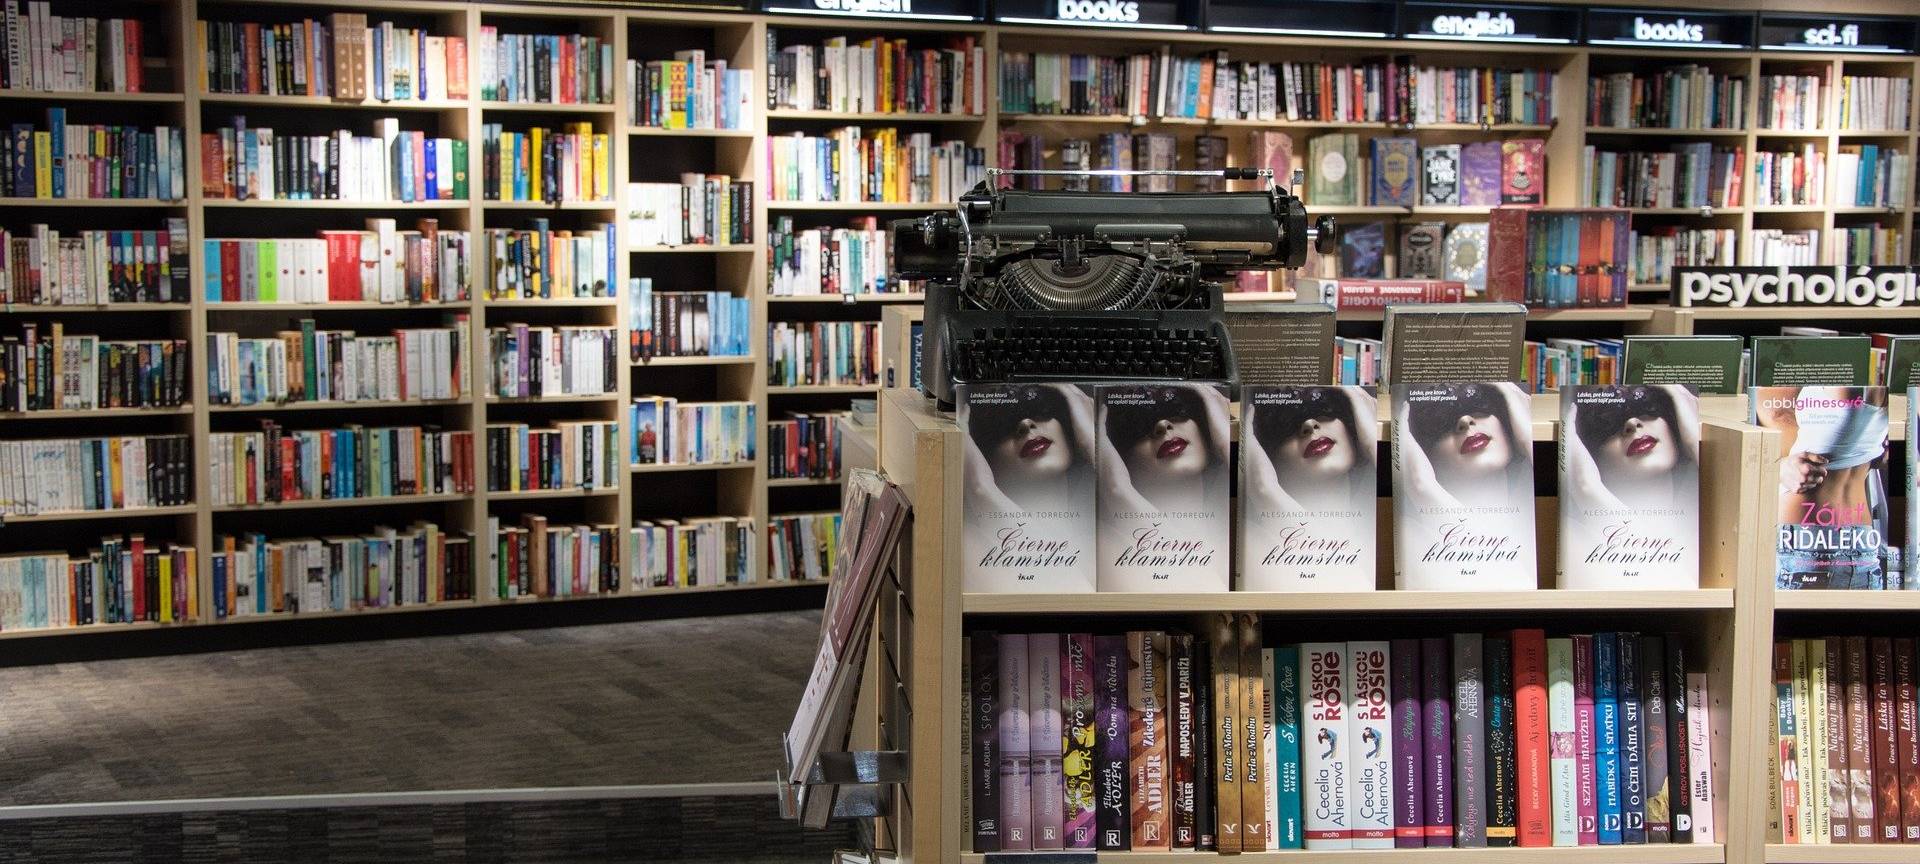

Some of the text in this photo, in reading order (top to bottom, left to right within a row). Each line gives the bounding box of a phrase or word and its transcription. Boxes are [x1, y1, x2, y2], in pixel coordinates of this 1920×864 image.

[1058, 0, 1139, 22] books
[1432, 11, 1515, 37] english
[1634, 17, 1703, 41] books
[1804, 24, 1858, 45] sci-fi
[1680, 265, 1920, 308] psychológi
[1037, 510, 1081, 519] TORREOVÁ
[1113, 510, 1216, 519] ALESSANDRA TORREOVÁ
[1260, 510, 1362, 518] ALESSANDRA TORREOVÁ
[1419, 506, 1521, 514] ALESSANDRA TORREOVÁ
[1583, 508, 1685, 516] ALESSANDRA TORREOVÁ
[1801, 501, 1865, 531] Zájsť
[997, 522, 1068, 551] Čierne
[1132, 522, 1203, 551] Čierne
[1280, 522, 1350, 550] Čierne
[1439, 518, 1509, 546] Čierne
[1603, 520, 1672, 548] Čierne
[1779, 527, 1881, 550] RIĎALEKO
[979, 546, 1080, 567] klamstvá
[1115, 546, 1215, 567] klamstvá
[1261, 545, 1361, 566] klamstvá
[1422, 542, 1521, 562] klamstvá
[1584, 544, 1684, 564] klamstvá
[1178, 657, 1190, 689] PARÍŽI
[1310, 652, 1323, 707] LÁSKOU
[1355, 651, 1369, 720] S LÁSKOU
[982, 672, 993, 729] SPOLOK
[1072, 643, 1085, 736] Prosím, mlč
[1110, 697, 1118, 709] na
[1143, 636, 1156, 747] Zdedené tajomstvo
[1459, 676, 1468, 711] CECELIA
[1467, 667, 1478, 718] AHERNOVÁ
[1652, 697, 1662, 713] Deb
[1827, 652, 1839, 751] Načúvaj môjmu srdcu
[1852, 652, 1864, 752] Načúvaj môjmu srdcu
[1876, 654, 1888, 731] Láska ťa vylieči
[1899, 655, 1911, 731] Láska ťa vylieči
[1281, 697, 1295, 728] láskou
[1528, 695, 1540, 744] Aj vdovy
[1626, 701, 1637, 721] SNÍ
[1785, 687, 1793, 724] Brooklynu
[1800, 707, 1807, 715] čo
[1818, 707, 1825, 716] čo
[1108, 713, 1118, 740] Dom
[1180, 702, 1190, 757] NAPOSLEDY
[1223, 716, 1233, 749] Moabu
[1248, 717, 1257, 749] Moabu
[1282, 729, 1295, 743] S
[1579, 709, 1590, 760] MANŽELŮ
[1628, 724, 1638, 761] DÁMA
[1080, 749, 1092, 806] ADLER
[1224, 758, 1233, 782] Perla
[1248, 758, 1257, 782] Perla
[1530, 748, 1539, 788] AIKMANOVÁ
[1626, 766, 1639, 792] ČEM
[1679, 721, 1689, 806] OSTROV POSLUŠNOSTI
[1103, 768, 1112, 808] Elizabeth
[1112, 761, 1123, 816] ADLER
[1147, 754, 1163, 814] ADLER
[1185, 782, 1194, 812] ADLER
[1315, 769, 1330, 820] Cecelia
[1331, 761, 1346, 827] Ahernová
[1359, 768, 1375, 819] Cecelia
[1378, 761, 1389, 826] Ahernová
[1406, 755, 1415, 824] Cecelia Ahernová
[1435, 754, 1444, 823] Cecelia Ahernová
[1495, 756, 1505, 824] Cecelia Ahernová
[1581, 764, 1592, 806] SEZNAM
[1605, 759, 1617, 806] NABÍDKA
[1700, 771, 1708, 802] Anaswah
[1804, 781, 1812, 807] počúvaš
[1821, 781, 1829, 808] počúvaš
[1631, 796, 1640, 805] O
